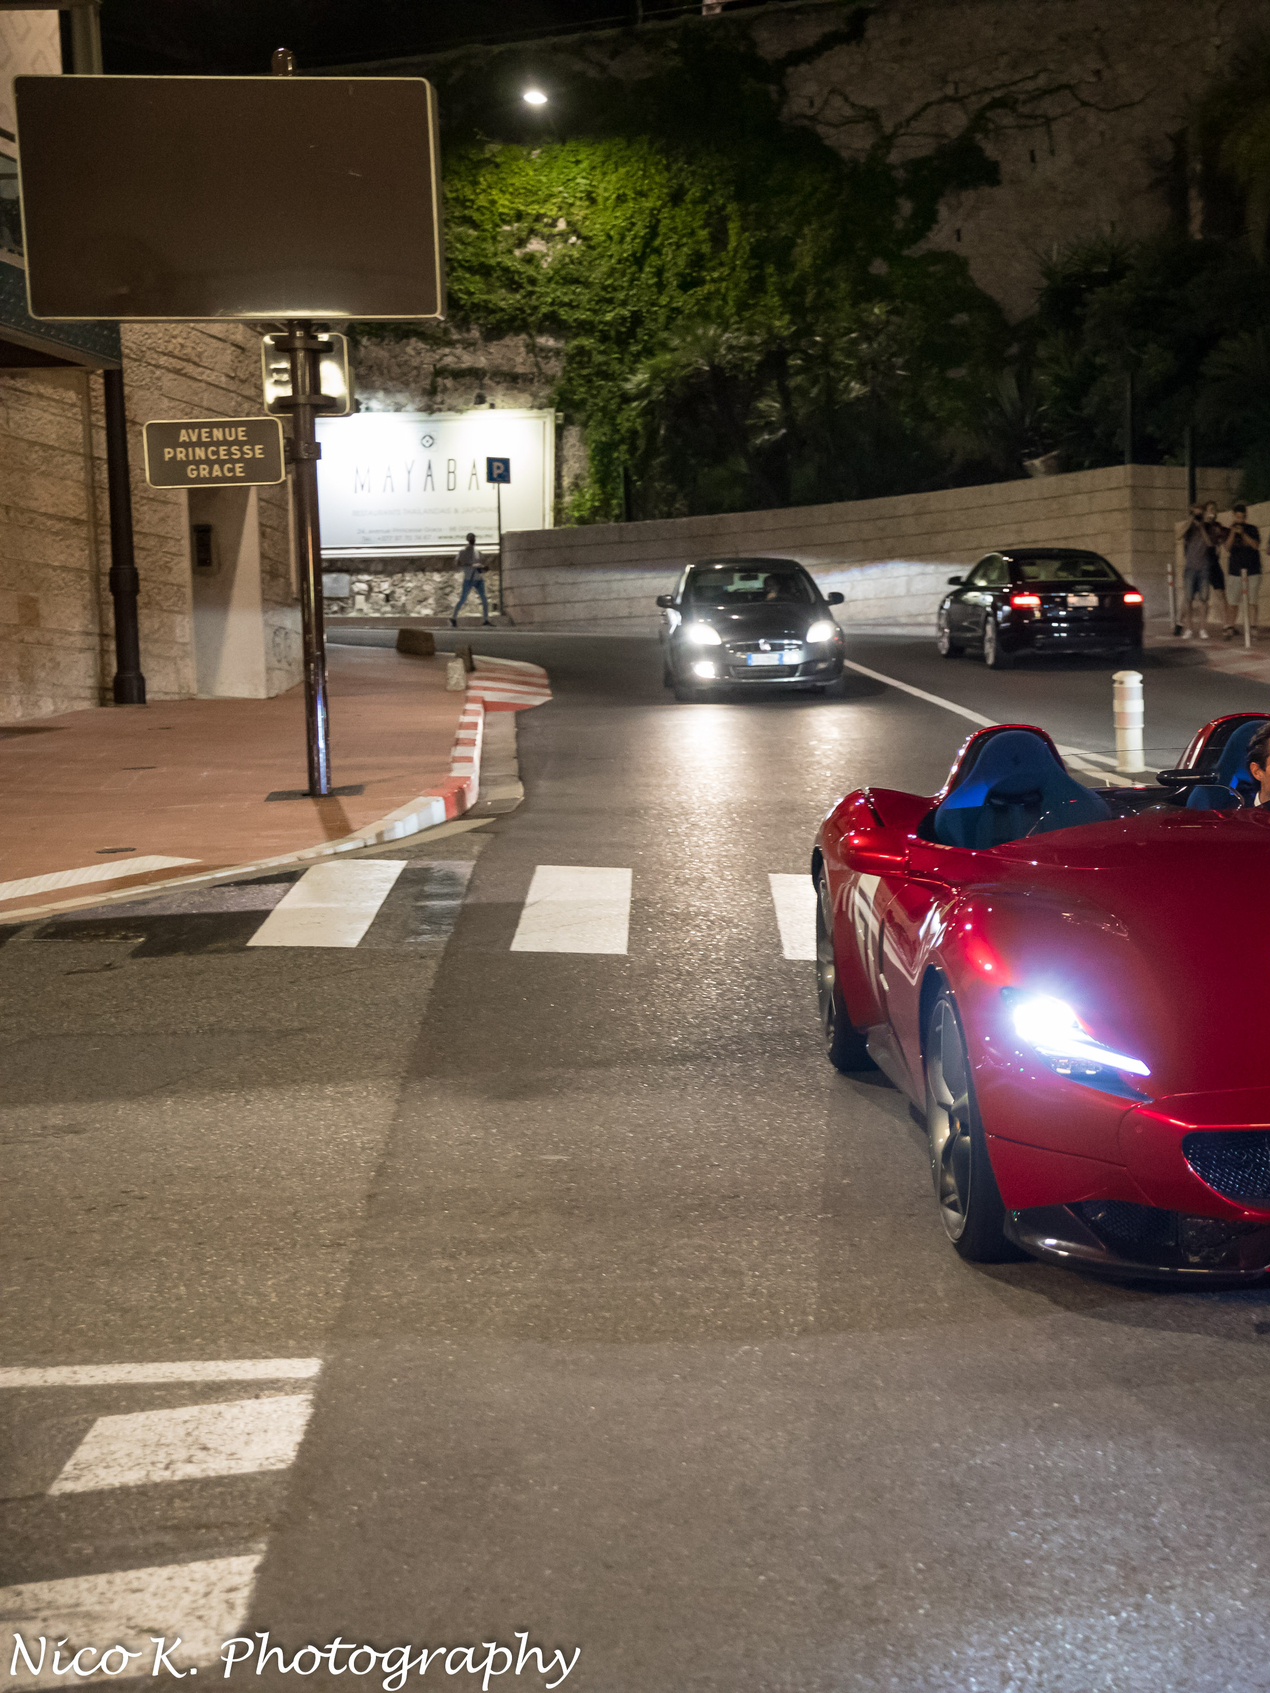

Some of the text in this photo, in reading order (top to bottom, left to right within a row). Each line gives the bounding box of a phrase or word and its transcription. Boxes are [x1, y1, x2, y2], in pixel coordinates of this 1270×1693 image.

[179, 427, 248, 442] AVENUE
[164, 445, 265, 461] PRINCESSE
[187, 463, 246, 478] GRACE
[354, 458, 497, 494] MAYABA
[492, 461, 505, 478] P
